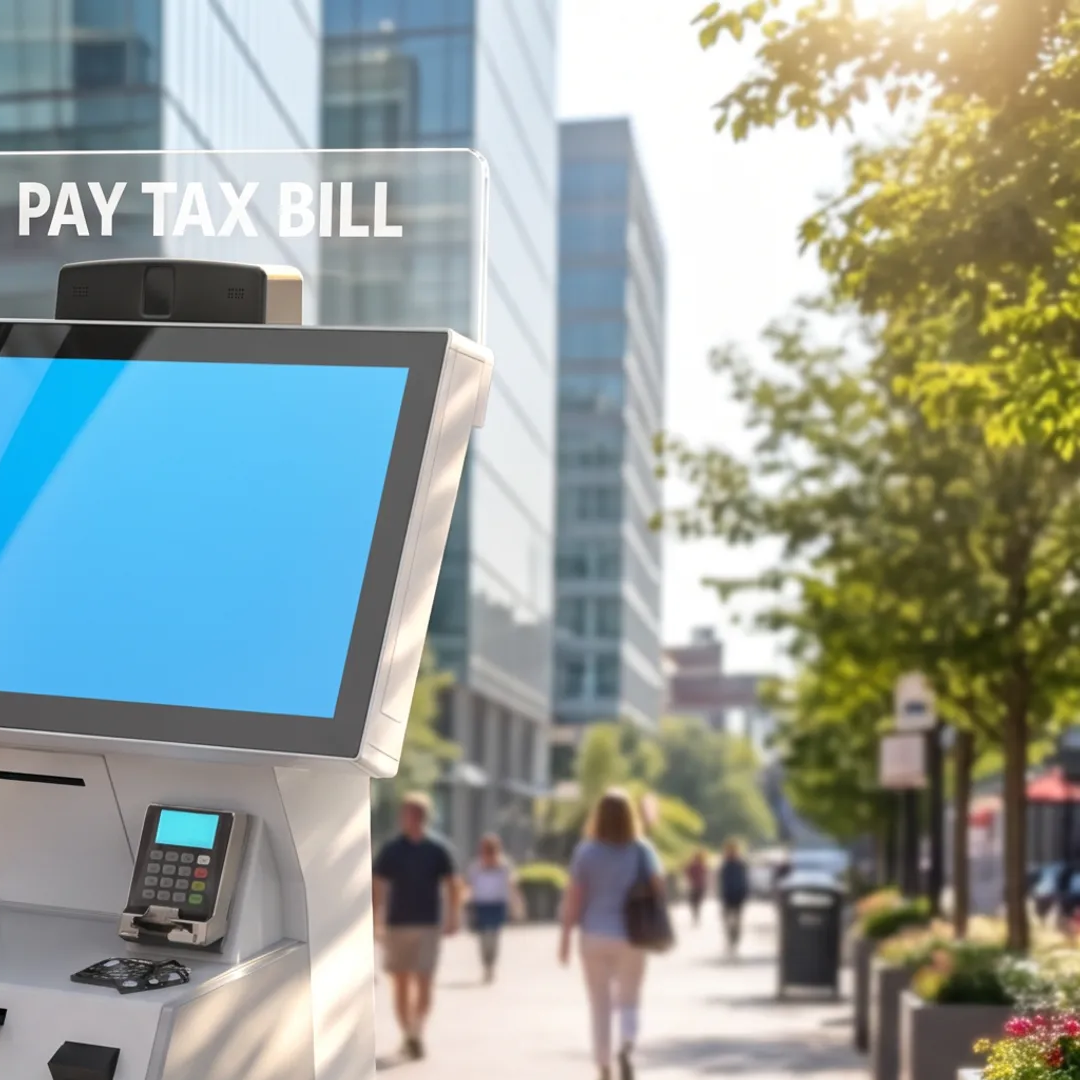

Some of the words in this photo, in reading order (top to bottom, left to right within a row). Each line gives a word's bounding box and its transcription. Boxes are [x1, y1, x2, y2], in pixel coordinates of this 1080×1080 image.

[18, 181, 127, 237] PAY
[141, 181, 260, 238] TAX
[277, 181, 403, 238] BILL
